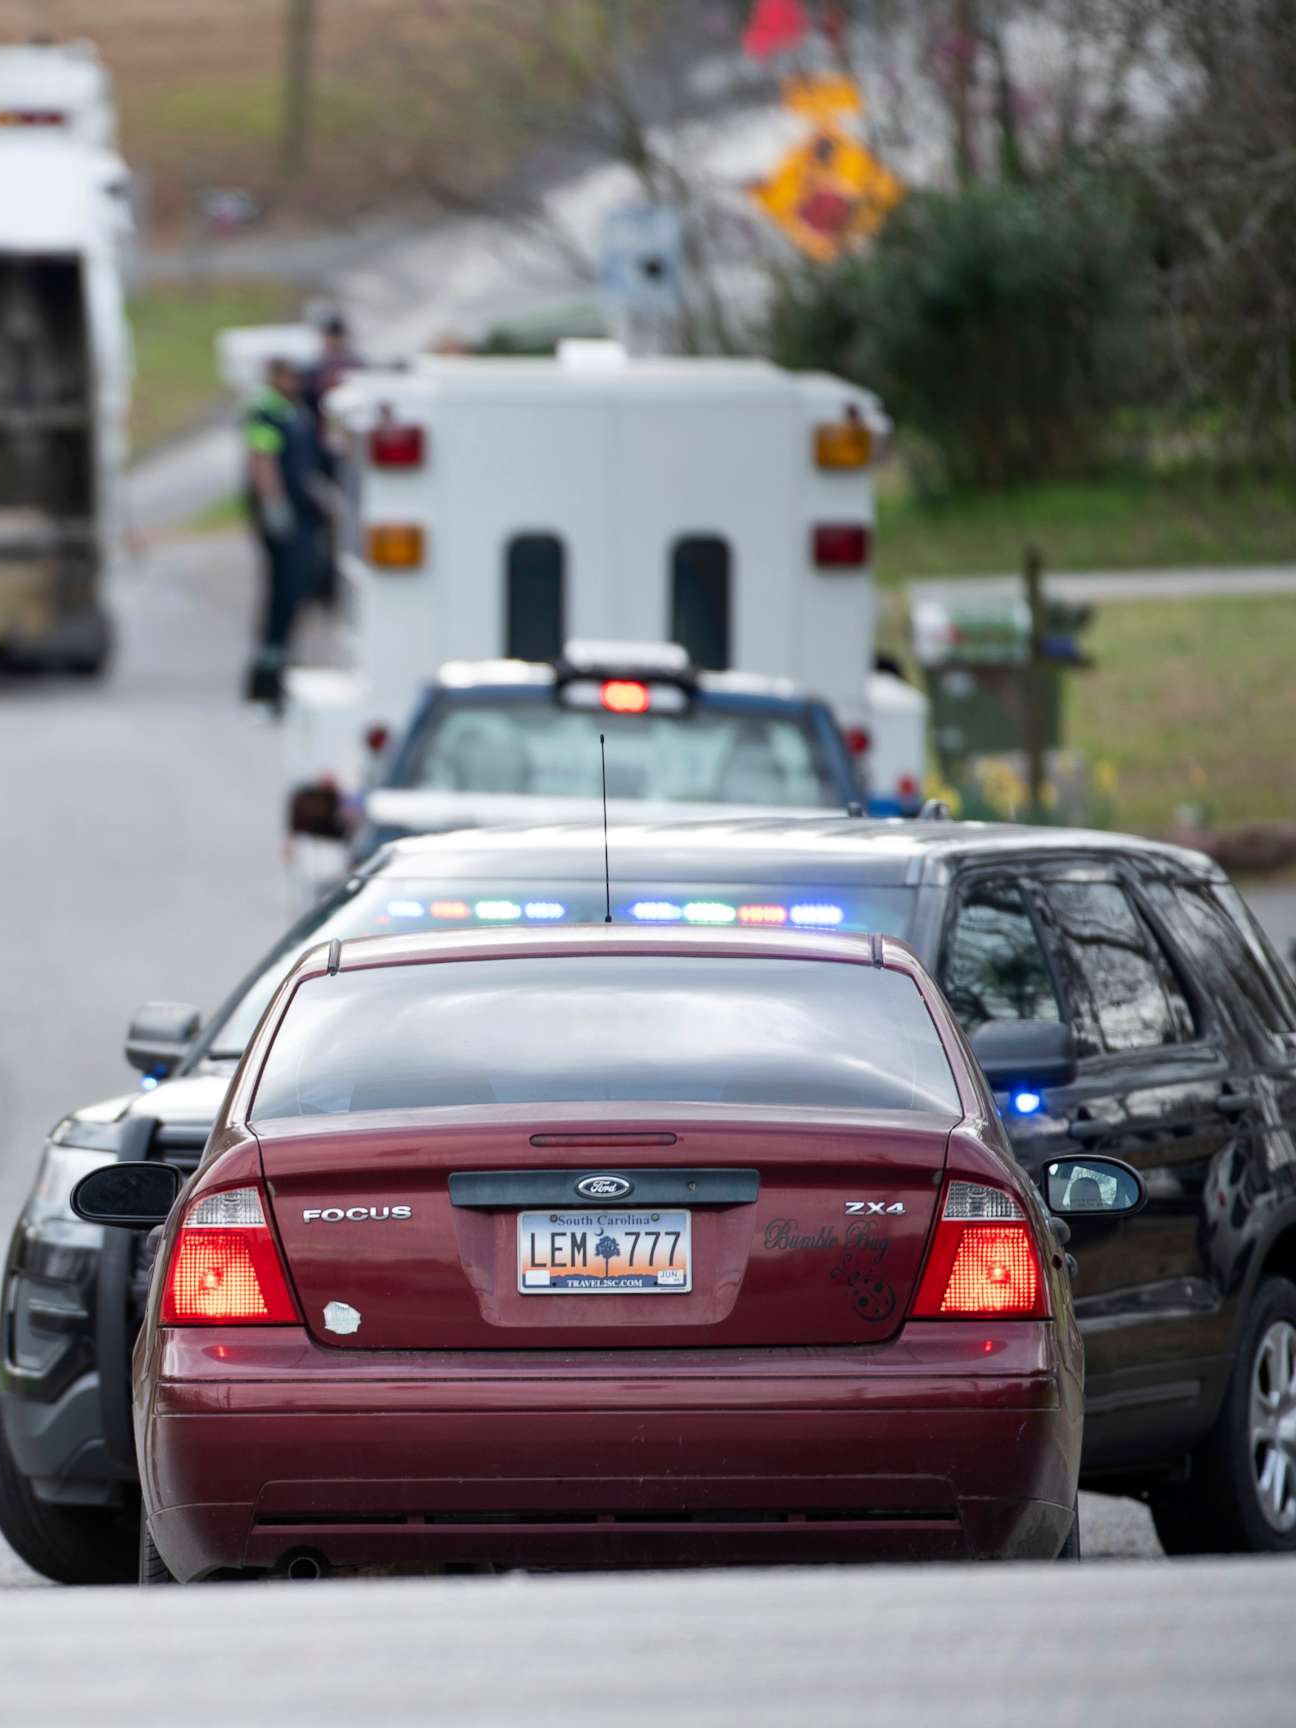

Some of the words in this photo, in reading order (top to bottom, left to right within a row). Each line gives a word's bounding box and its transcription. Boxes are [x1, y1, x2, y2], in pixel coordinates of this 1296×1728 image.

[590, 1180, 617, 1193] Ford
[303, 1206, 412, 1223] FOCUS
[845, 1201, 906, 1215] ZX4
[557, 1214, 593, 1226] South
[597, 1214, 650, 1226] Carolina
[763, 1218, 838, 1249] Bumble
[530, 1232, 587, 1267] LEM
[625, 1231, 681, 1267] 777
[566, 1279, 643, 1288] TRAVEL2SC.COM
